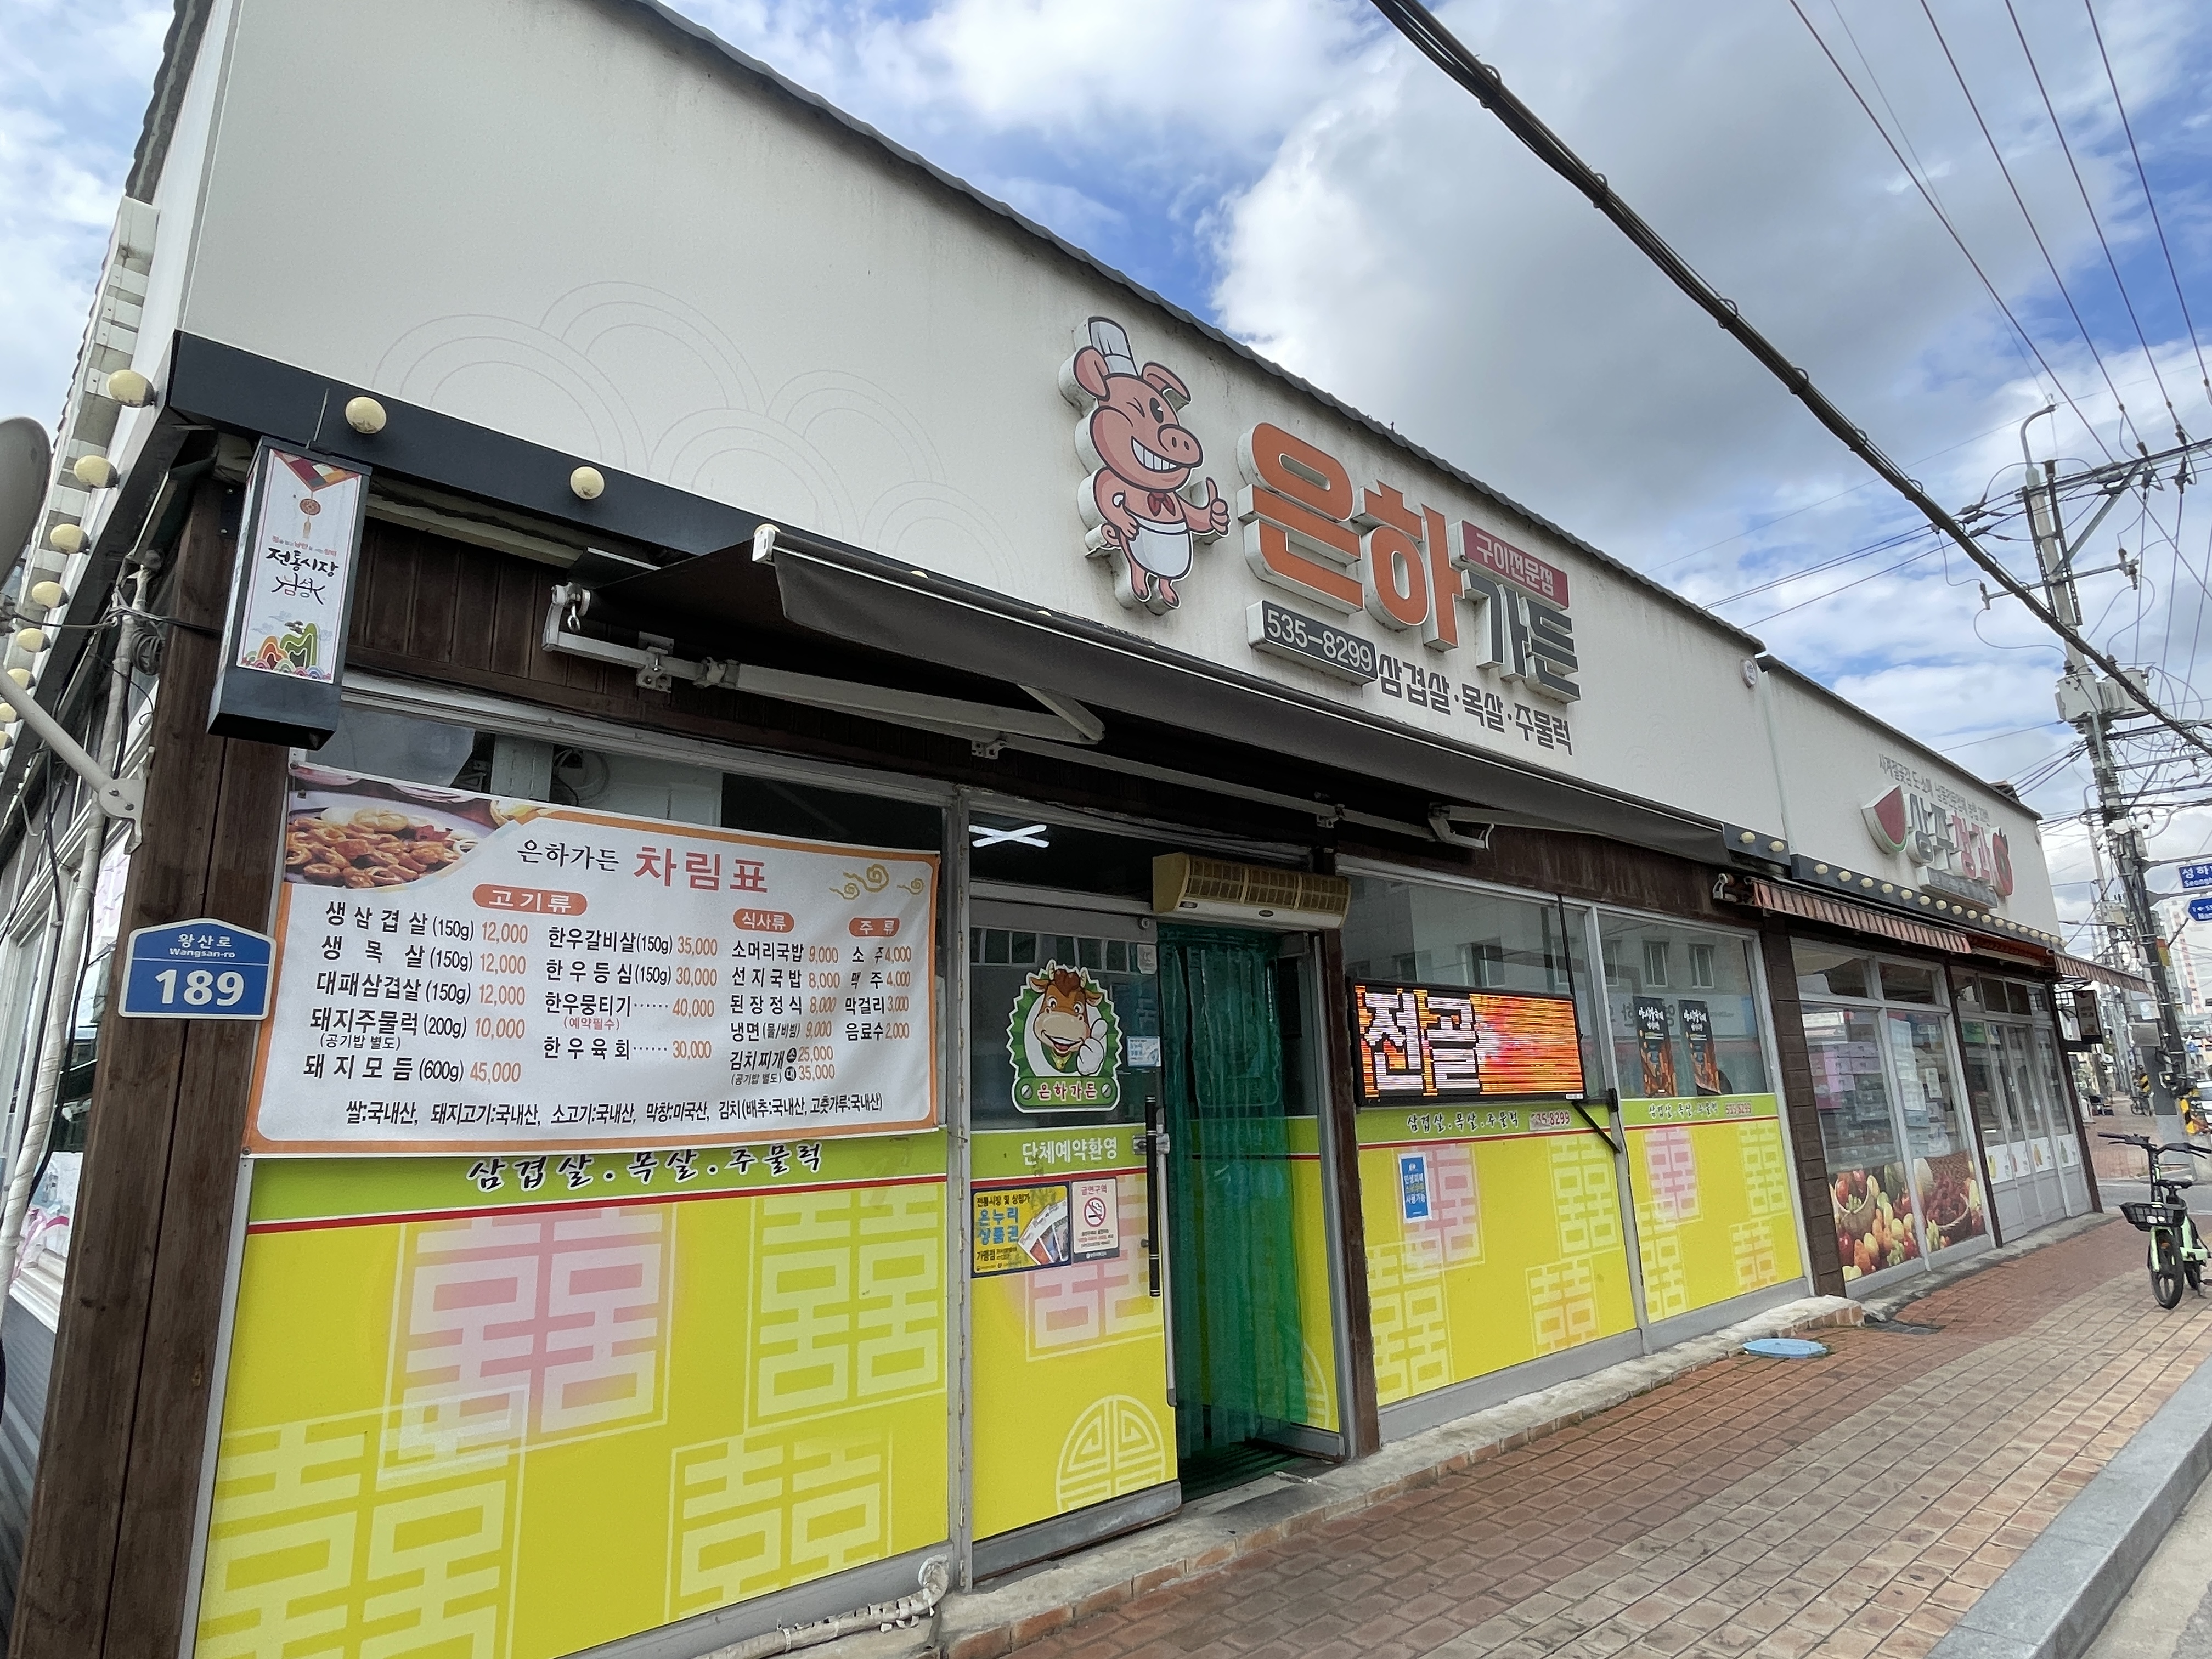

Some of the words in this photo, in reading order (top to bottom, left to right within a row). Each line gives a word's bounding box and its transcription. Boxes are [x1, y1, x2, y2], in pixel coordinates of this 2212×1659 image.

[266, 548, 339, 577] 전통시장
[1245, 422, 1464, 648] 은하
[1464, 569, 1581, 701] 가든
[1476, 532, 1554, 597] 구이전문점
[1266, 608, 1372, 672] 535-8299
[517, 839, 619, 872] 은하가든
[633, 846, 768, 893] 차림표
[488, 890, 572, 913] 고기류
[432, 915, 475, 941] (150g)
[481, 922, 529, 945] 12,000
[742, 912, 786, 932] 식사류
[859, 921, 895, 935] 주류
[178, 933, 232, 949] 왕산로
[677, 935, 718, 956] 35,000
[731, 940, 804, 963] 소머리국밥
[809, 945, 839, 964] 9,000
[169, 947, 236, 958] Wangsan-ro
[430, 946, 473, 972] (150g)
[479, 953, 527, 975] 12,000
[885, 945, 912, 963] 4,000
[155, 969, 245, 1006] 189
[315, 970, 422, 1002] 대패삼겹살
[425, 979, 471, 1005] (150g)
[479, 985, 526, 1007] 12,000
[676, 967, 718, 988] 30,000
[809, 972, 840, 989] 8,000
[887, 970, 911, 988] 4,000
[545, 991, 631, 1018] 한우뭉티기
[672, 998, 715, 1019] 40,000
[730, 994, 803, 1016] 된장정식
[810, 996, 837, 1014] 8,000
[845, 996, 885, 1015] 막걸리
[887, 995, 910, 1012] 3,000
[309, 1006, 419, 1036] 돼지주물럭
[423, 1015, 467, 1039] (200g)
[475, 1017, 526, 1040] 10,000
[563, 1017, 621, 1031] (예약필수)
[730, 1022, 760, 1042] 냉면
[805, 1020, 833, 1040] 9,000
[845, 1022, 884, 1042] 음료수
[885, 1022, 910, 1040] 2,000
[319, 1032, 366, 1049] (공기밥
[369, 1035, 402, 1051] 별도)
[673, 1040, 712, 1060] 30,000
[1363, 992, 1480, 1090] 전골
[730, 1049, 786, 1071] 김치찌개
[798, 1045, 834, 1063] 25,000
[418, 1058, 464, 1083] (600g)
[469, 1061, 522, 1085] 45,000
[731, 1073, 761, 1085] (공기밥
[798, 1065, 836, 1082] 35,000
[1038, 1082, 1097, 1101] 은하가든
[346, 1101, 419, 1125] 쌀:국내산,
[430, 1102, 541, 1127] 돼지고기:국내산,
[551, 1102, 637, 1125] 소고기:국내산,
[1022, 1137, 1118, 1166] 단체예약환영
[978, 1206, 1019, 1227] 온누리
